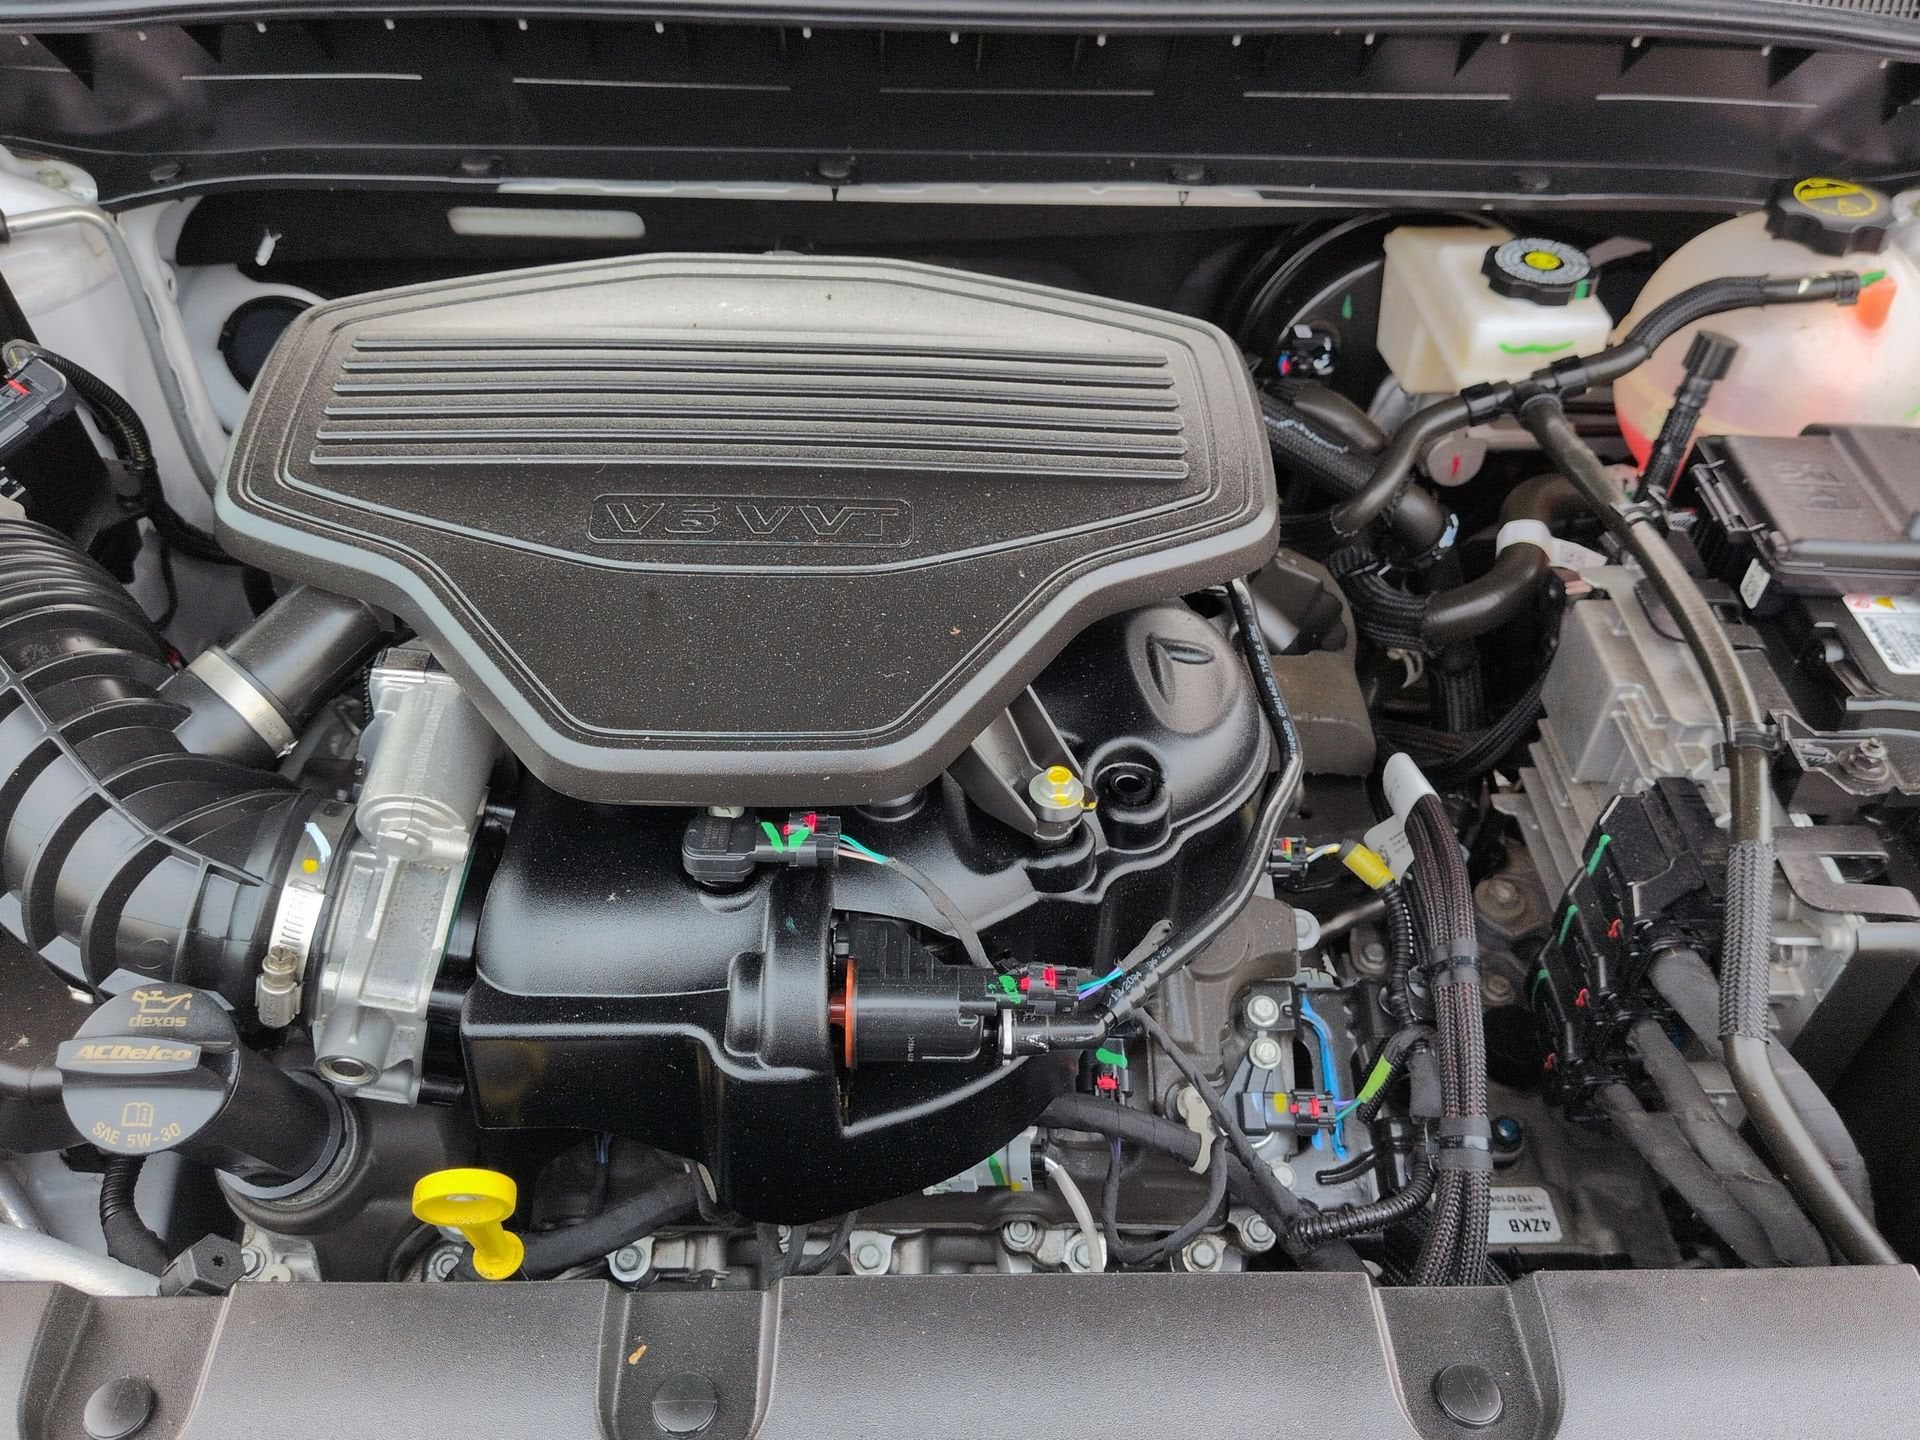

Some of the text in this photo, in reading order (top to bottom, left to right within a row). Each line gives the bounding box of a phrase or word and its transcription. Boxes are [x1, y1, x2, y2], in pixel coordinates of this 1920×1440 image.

[735, 504, 901, 537] VVT
[128, 1014, 189, 1028] dexos
[73, 1044, 193, 1061] ACDelco
[92, 1121, 182, 1148] SAE 5W-30
[1508, 1218, 1551, 1233] 4ZKB
